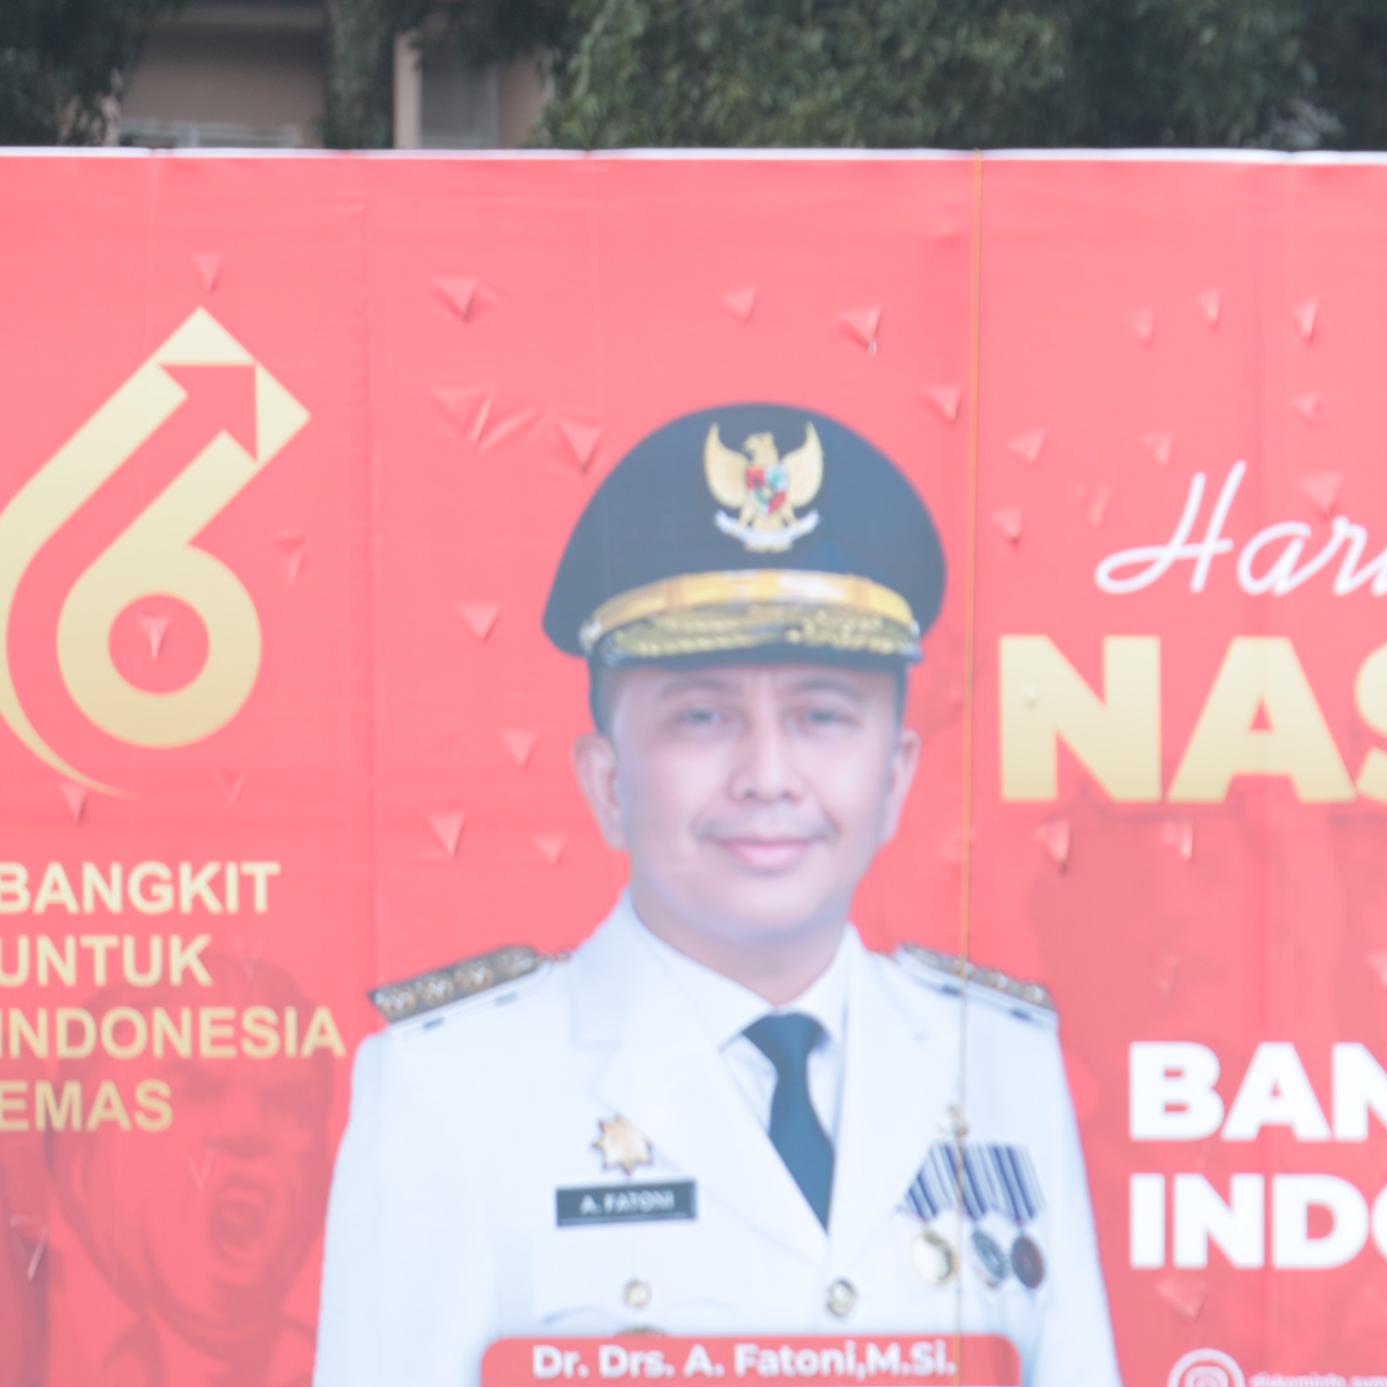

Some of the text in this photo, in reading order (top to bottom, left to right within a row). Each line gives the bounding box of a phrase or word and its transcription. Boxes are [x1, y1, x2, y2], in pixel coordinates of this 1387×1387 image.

[0, 862, 281, 914] BANGKIT
[0, 934, 213, 986] UNTUK
[0, 1079, 173, 1131] EMAS
[532, 1345, 589, 1379] Dr.
[598, 1344, 675, 1378] Drs.
[683, 1344, 725, 1377] A.
